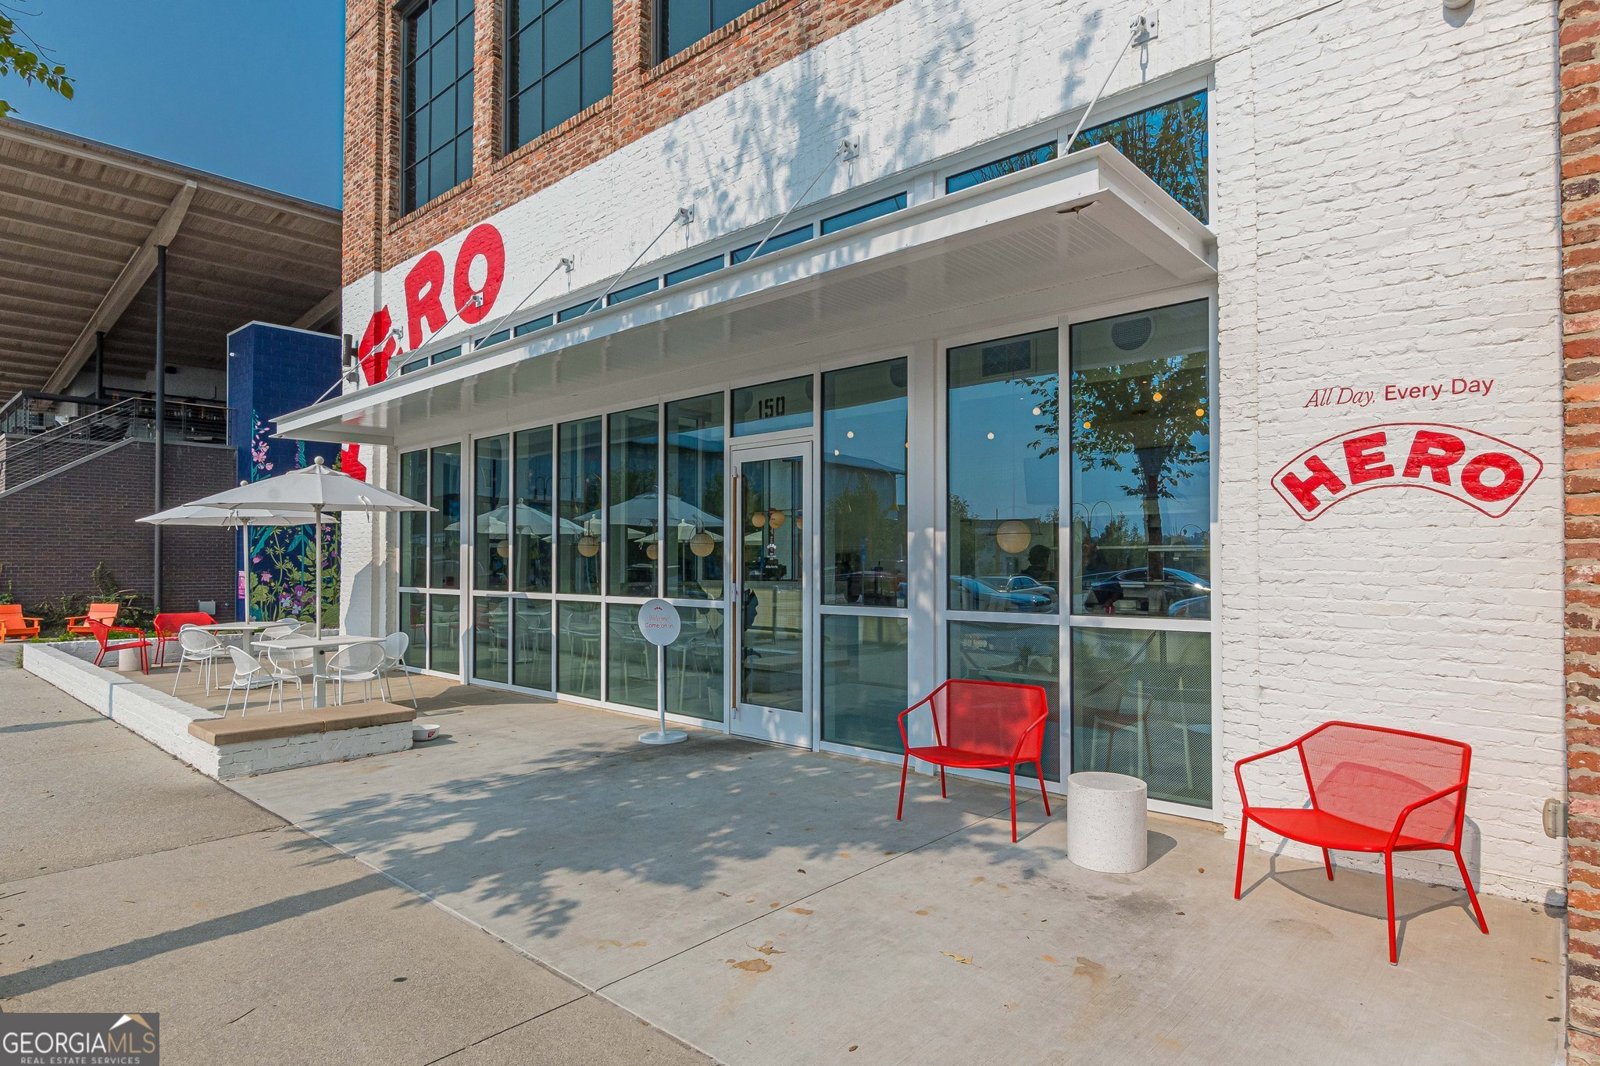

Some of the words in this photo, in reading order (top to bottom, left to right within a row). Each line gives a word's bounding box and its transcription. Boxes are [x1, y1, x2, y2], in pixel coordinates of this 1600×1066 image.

[759, 396, 785, 419] 150
[1303, 388, 1332, 408] All
[1384, 384, 1443, 401] Every
[1451, 378, 1494, 397] Day
[1281, 430, 1525, 512] HERO
